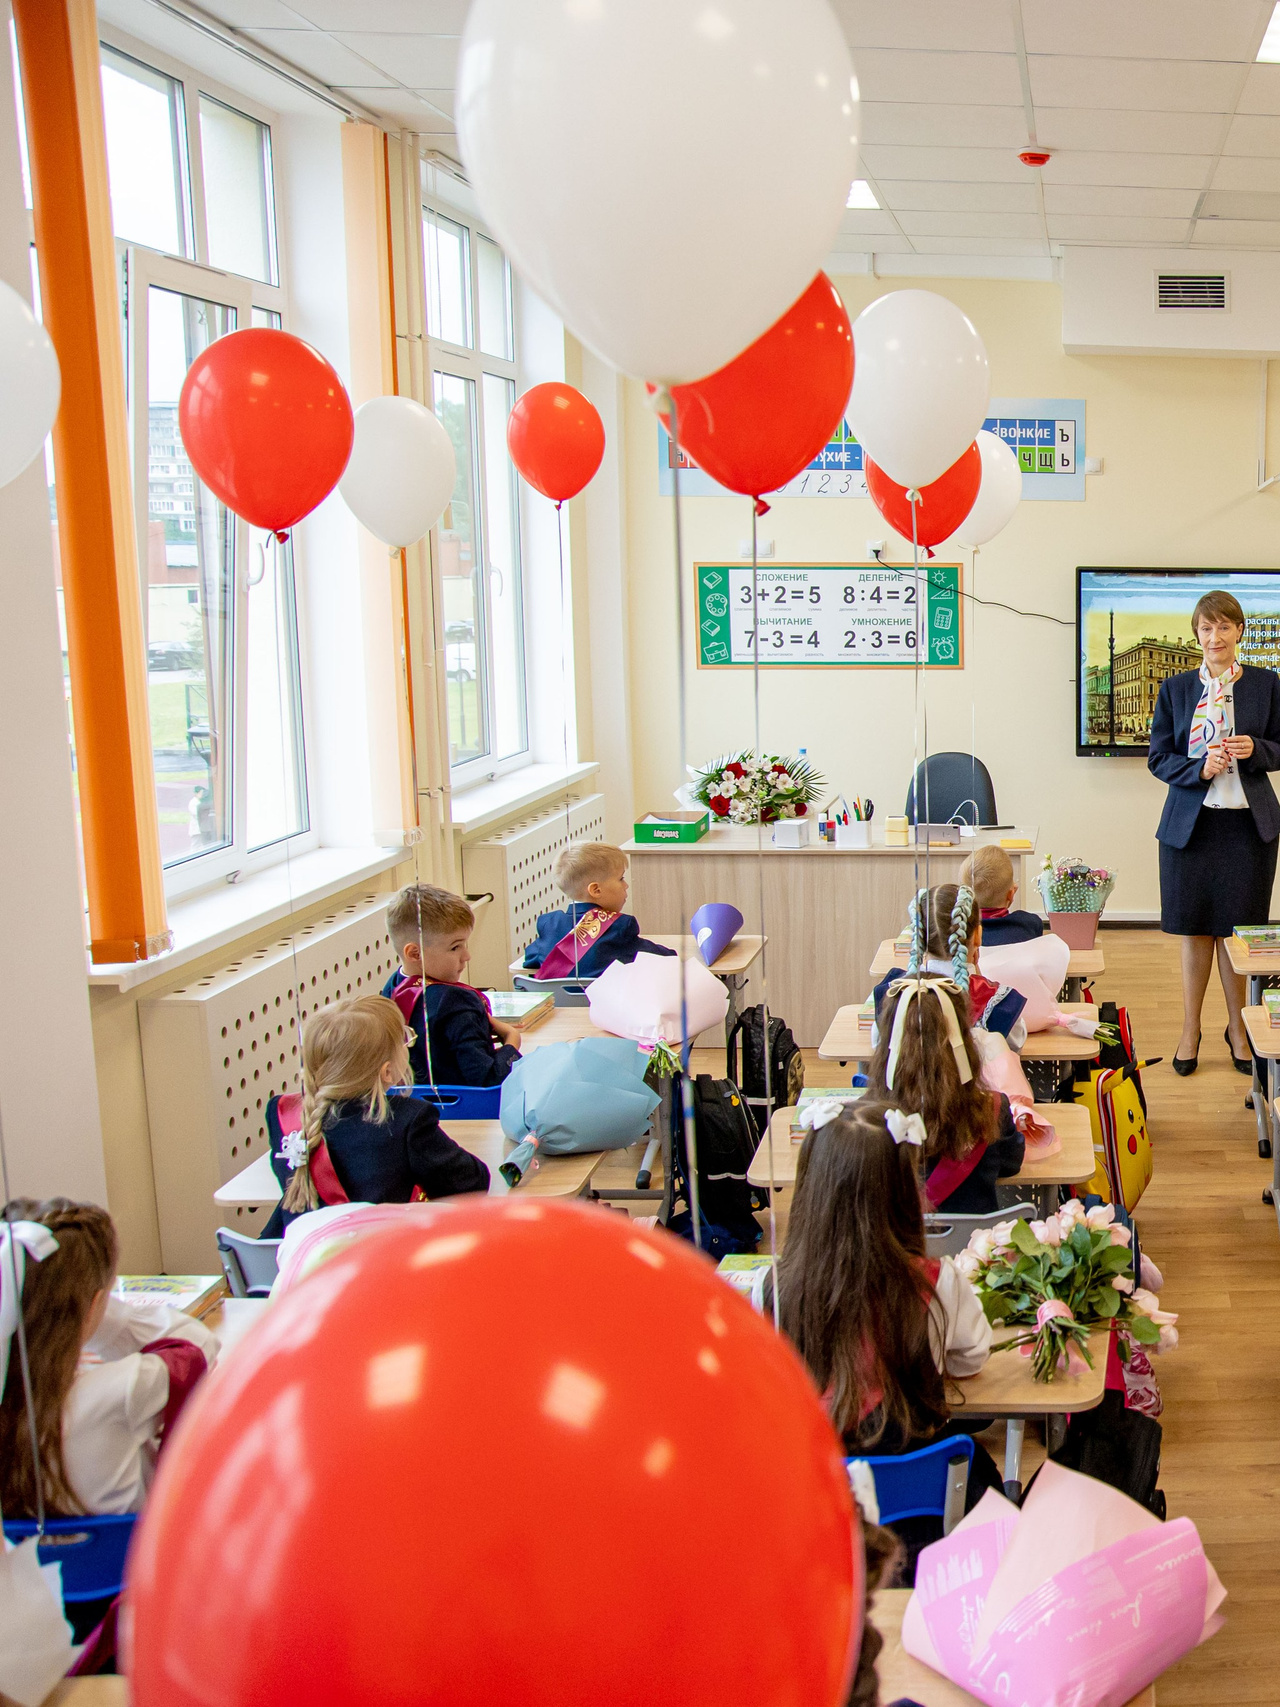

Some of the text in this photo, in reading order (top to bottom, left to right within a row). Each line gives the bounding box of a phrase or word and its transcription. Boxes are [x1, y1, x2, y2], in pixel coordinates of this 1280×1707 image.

[992, 427, 1070, 442] ЗВОНКИЕ Ъ
[815, 452, 851, 462] УХИЕ
[1022, 453, 1070, 468] Ч Щ Ь
[801, 474, 810, 493] 1
[817, 474, 831, 493] 2
[839, 474, 852, 493] 3
[756, 574, 809, 582] СЛОЖЕНИЕ
[858, 574, 904, 582] ДЕЛЕНИЕ
[1239, 641, 1262, 650] Идет
